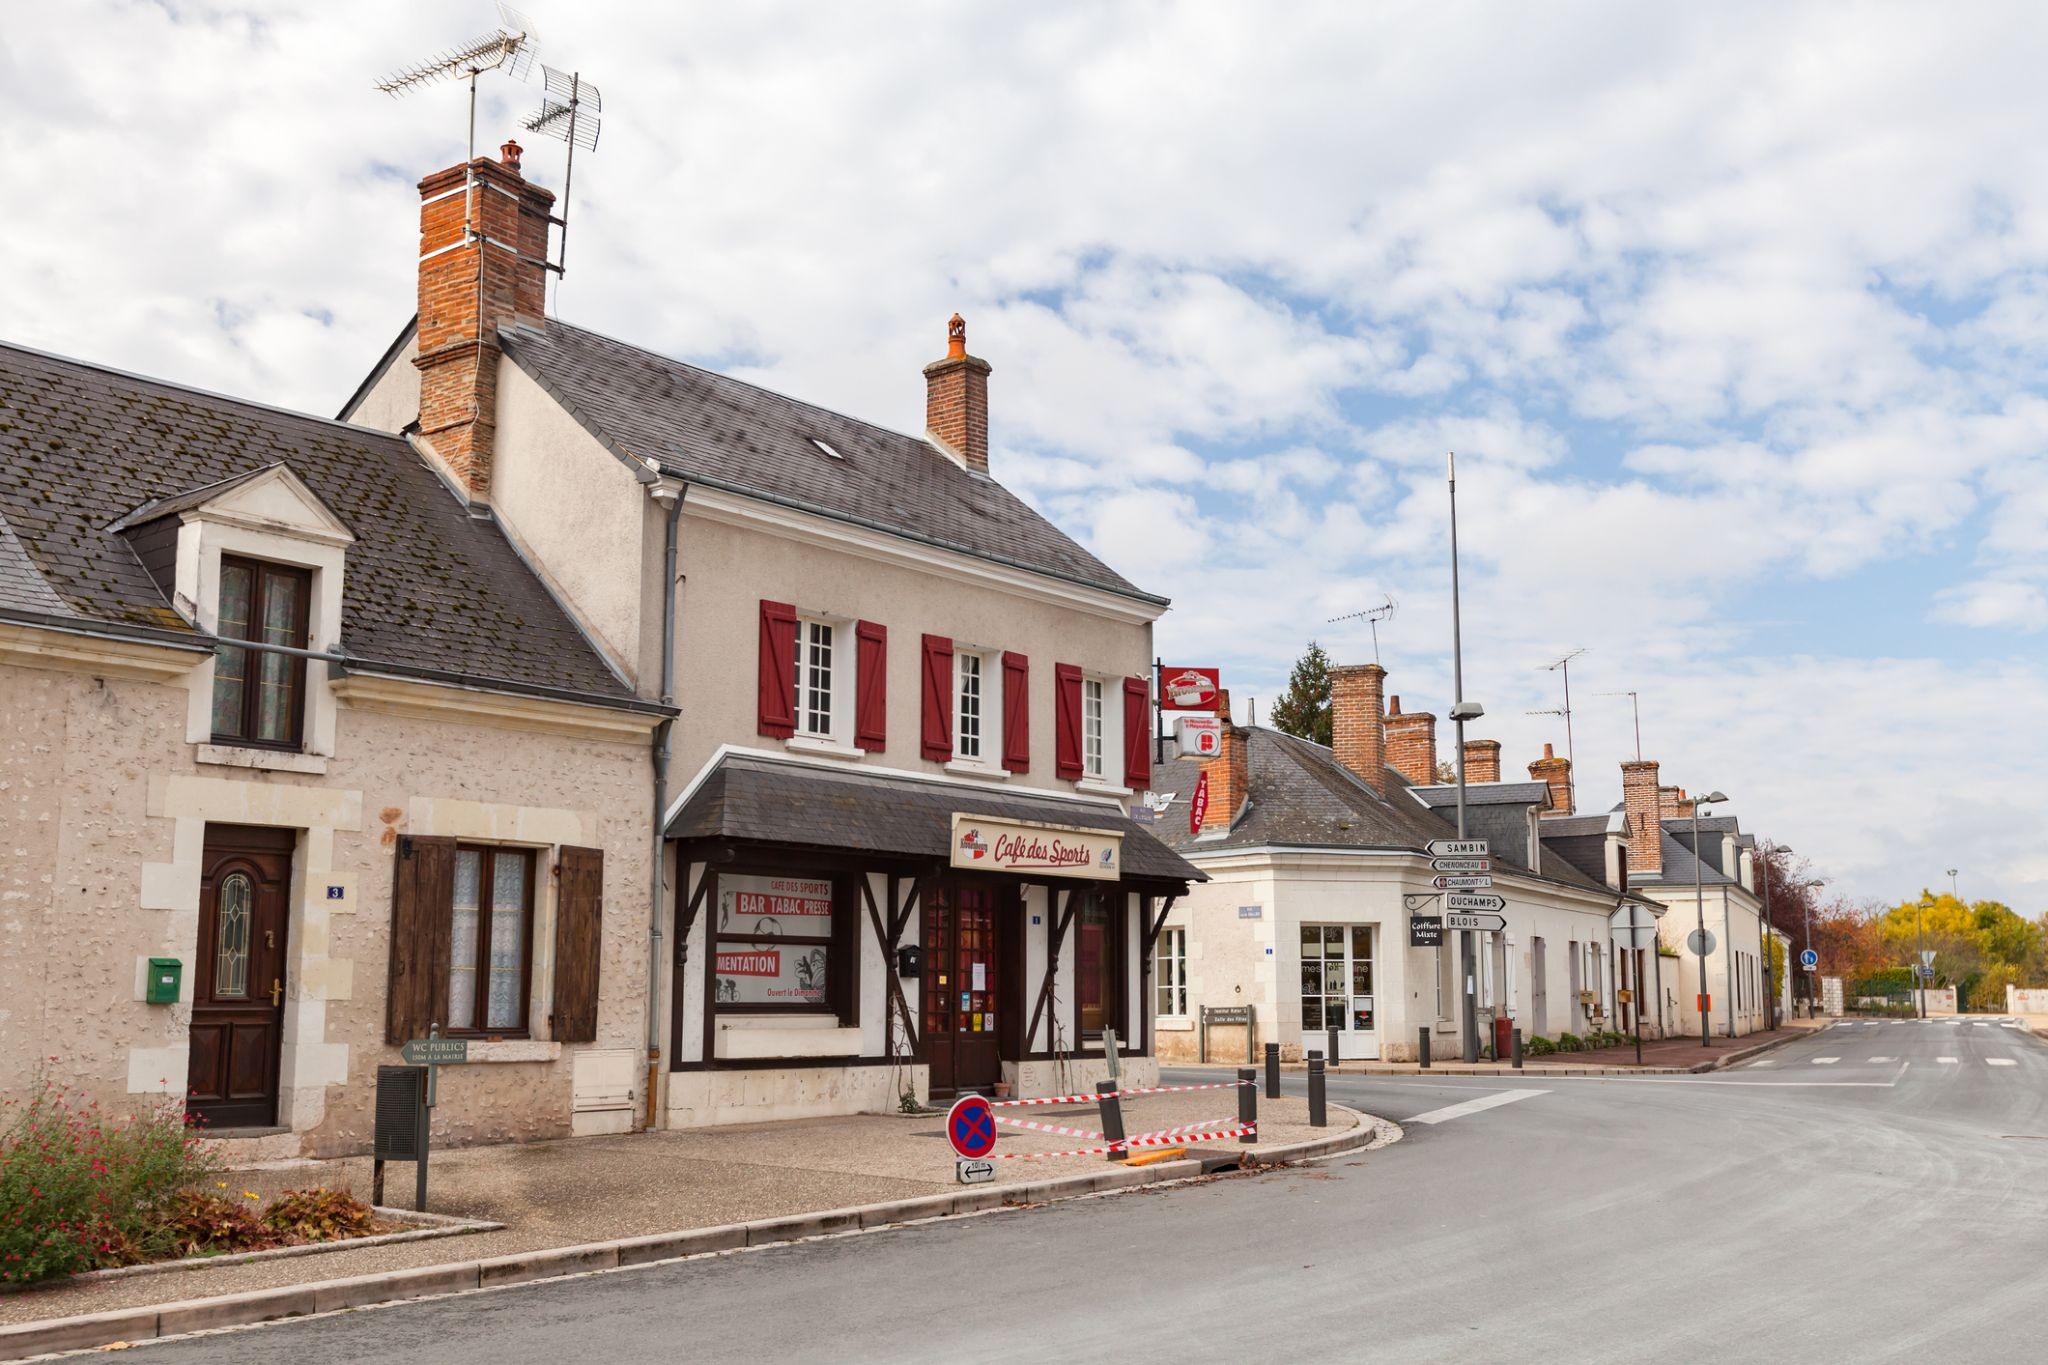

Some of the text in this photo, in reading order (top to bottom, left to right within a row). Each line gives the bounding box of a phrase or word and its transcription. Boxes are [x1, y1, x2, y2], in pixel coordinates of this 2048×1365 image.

[1194, 780, 1206, 825] TABAC
[994, 833, 1090, 867] Café des Sports
[1447, 844, 1486, 853] SAMBIN
[1439, 861, 1480, 869] CHENONCEAU
[1447, 878, 1479, 887] CHAUMONT
[332, 888, 338, 898] 3
[786, 882, 798, 892] DES
[800, 883, 828, 895] SPORTS
[740, 894, 829, 915] BAR TABAC PRESSE
[1450, 896, 1497, 907] OUCHAMPS
[1412, 921, 1441, 931] Coiffure
[1450, 917, 1479, 926] BLOIS
[1416, 931, 1437, 939] Mixte
[717, 956, 776, 973] MENTATION
[768, 988, 786, 997] Ouvert
[413, 1043, 465, 1052] WC PUBLICS
